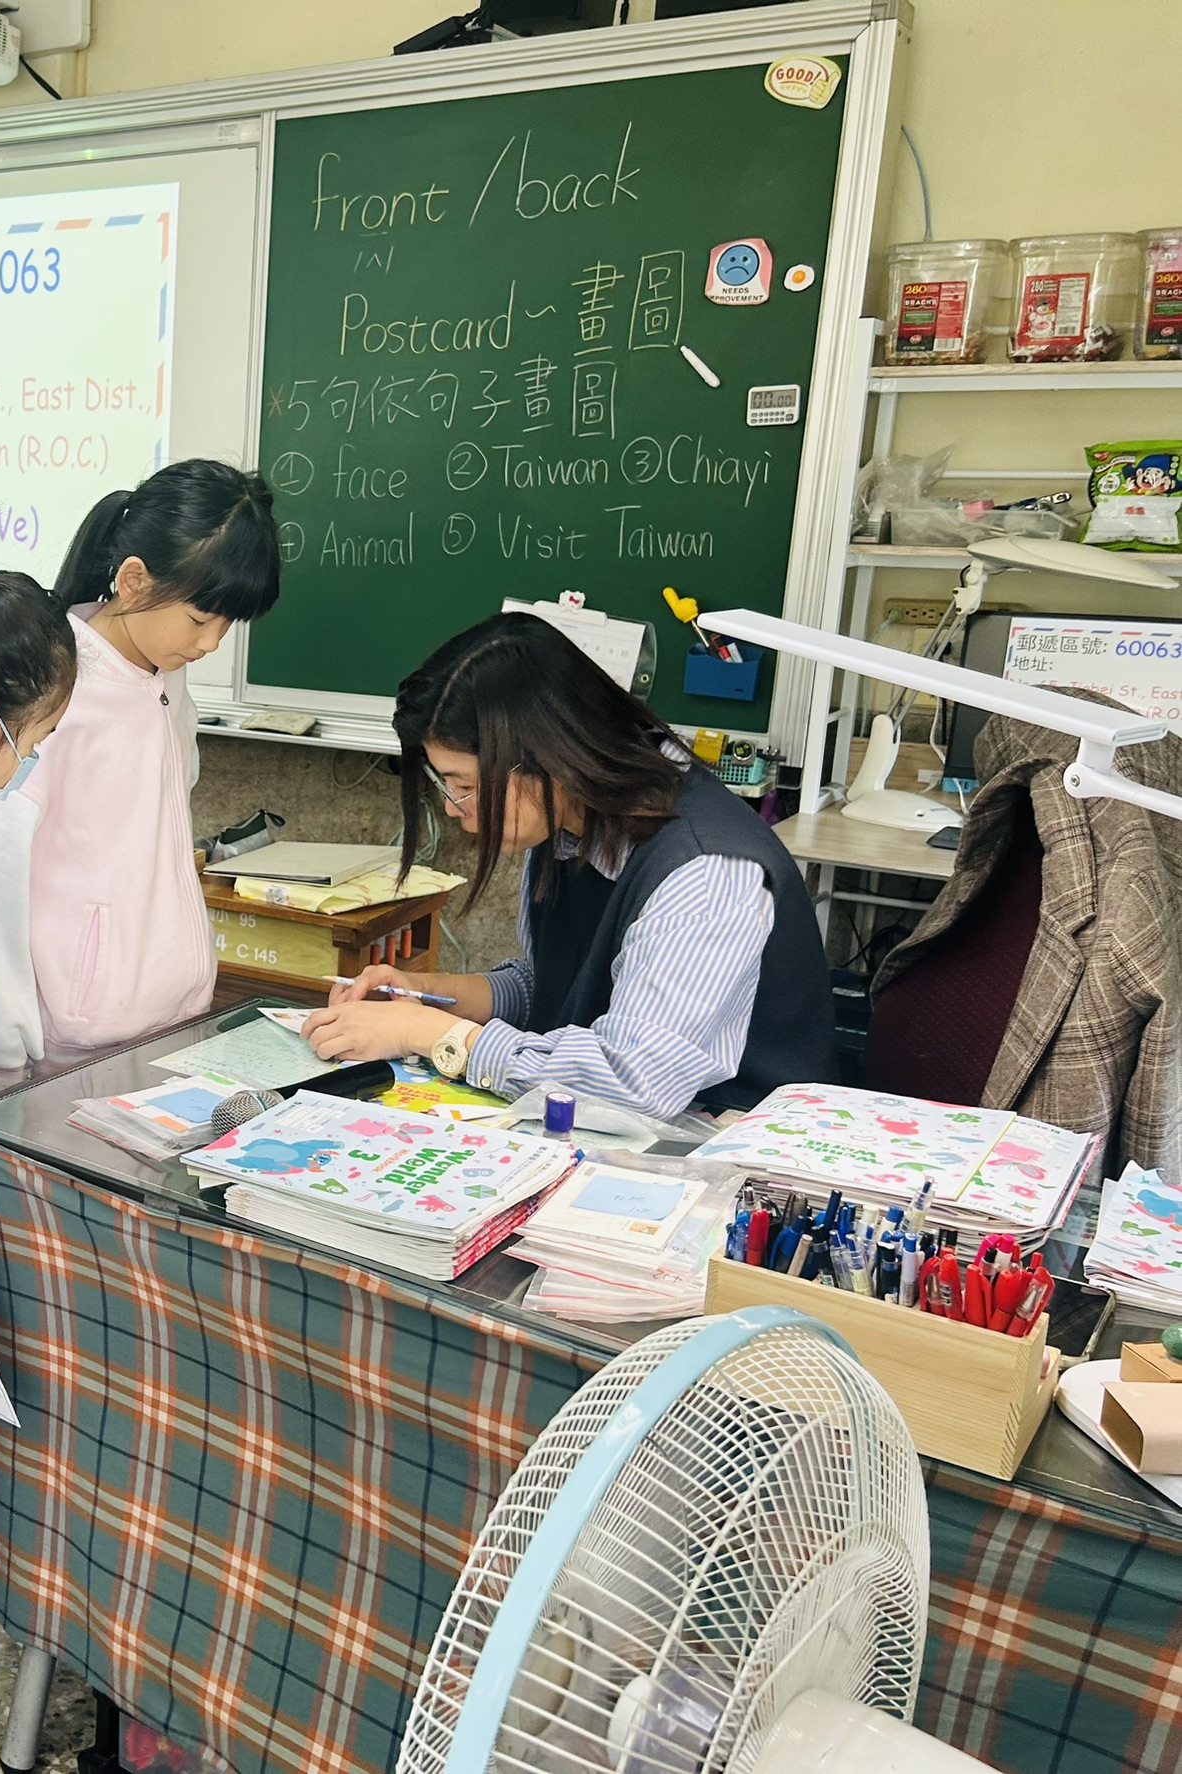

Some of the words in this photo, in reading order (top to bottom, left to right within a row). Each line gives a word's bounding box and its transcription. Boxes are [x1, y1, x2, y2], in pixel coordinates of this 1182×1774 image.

[776, 67, 822, 86] GOOD!
[312, 152, 450, 231] front
[516, 122, 641, 219] back
[709, 294, 764, 302] MPROVEMENT
[905, 285, 927, 294] 260
[22, 378, 74, 412] East
[18, 434, 110, 475] (R.O.C.)
[333, 444, 407, 499] face
[491, 443, 609, 488] Taiwan
[666, 435, 771, 508] Chiayi
[320, 512, 414, 568] Animal
[497, 512, 587, 562] Visit
[605, 505, 714, 559] Taiwan
[1016, 633, 1108, 656] 郵遞區號:
[1115, 640, 1182, 659] 60063
[1012, 656, 1054, 672] 地址:
[239, 912, 256, 928] 95
[236, 943, 249, 959] C
[253, 947, 278, 964] 145
[348, 1149, 381, 1161] 3
[375, 1148, 447, 1184] World
[403, 1150, 476, 1195] Wonder
